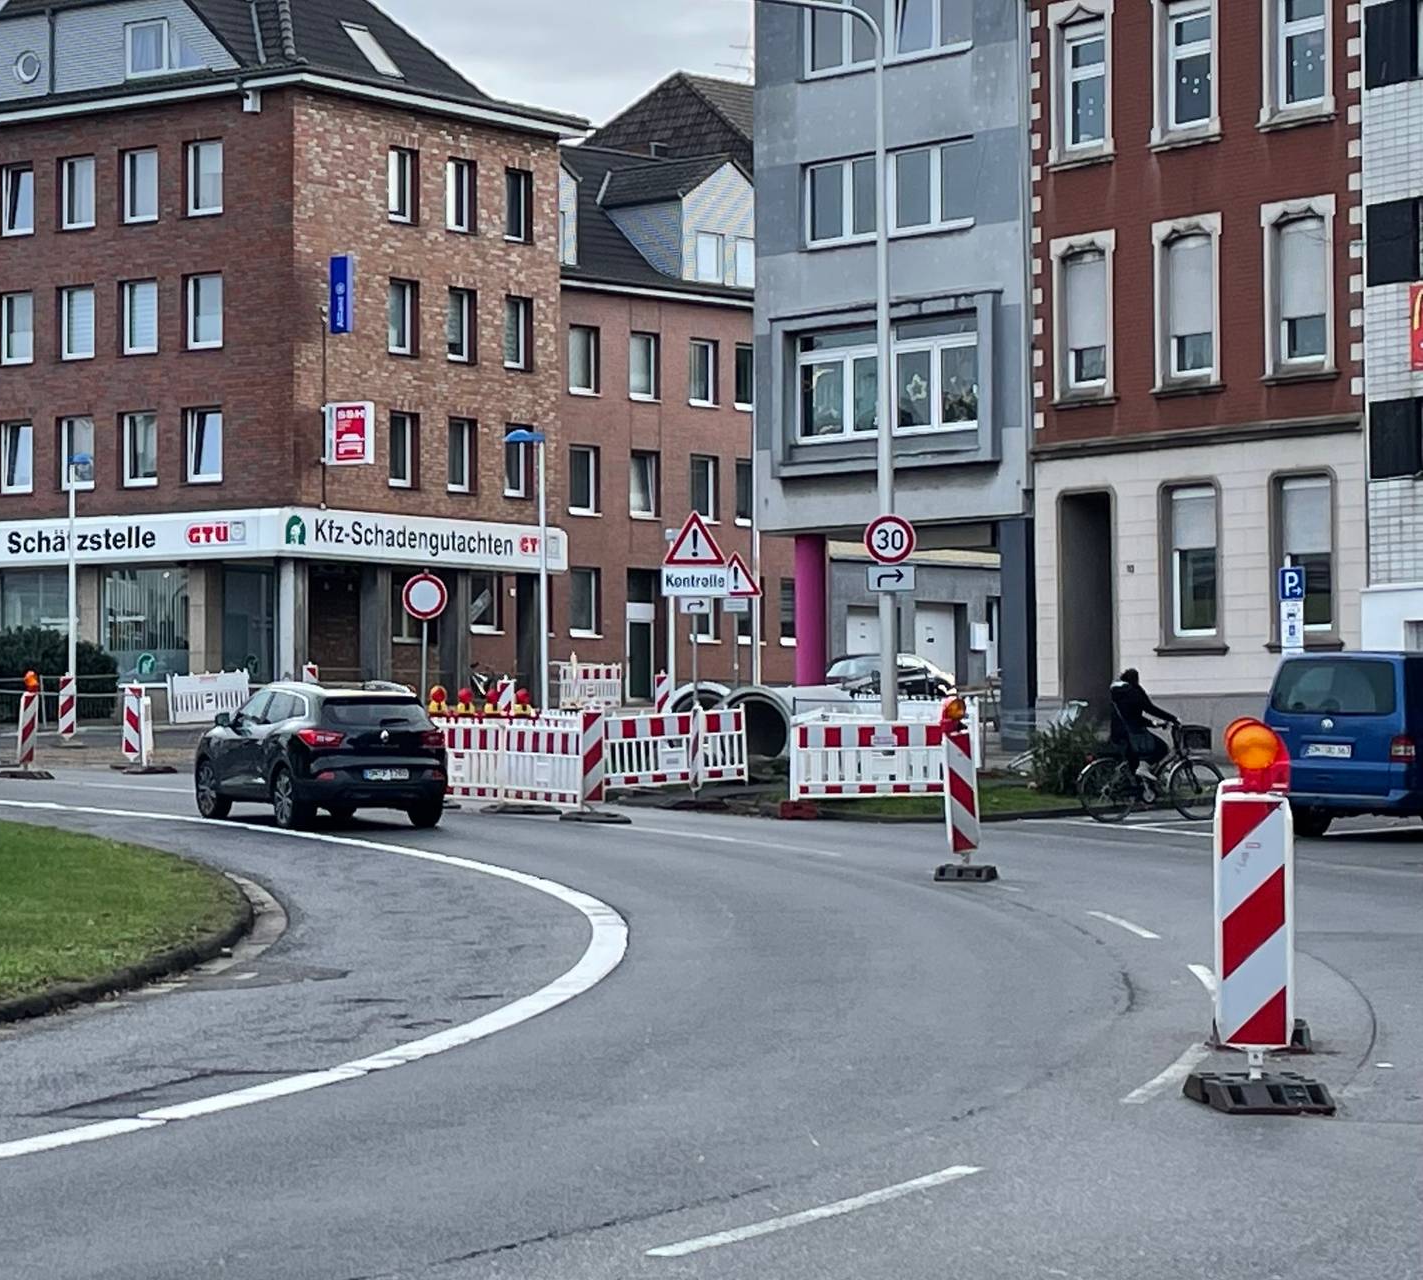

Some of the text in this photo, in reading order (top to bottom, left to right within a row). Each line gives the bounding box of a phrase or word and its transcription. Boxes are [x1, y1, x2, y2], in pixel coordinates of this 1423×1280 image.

[314, 518, 513, 557] Kfz-Schadengutachten
[520, 536, 541, 553] GT
[877, 529, 904, 550] 30
[665, 573, 726, 588] Kontrolle
[1284, 571, 1299, 597] P
